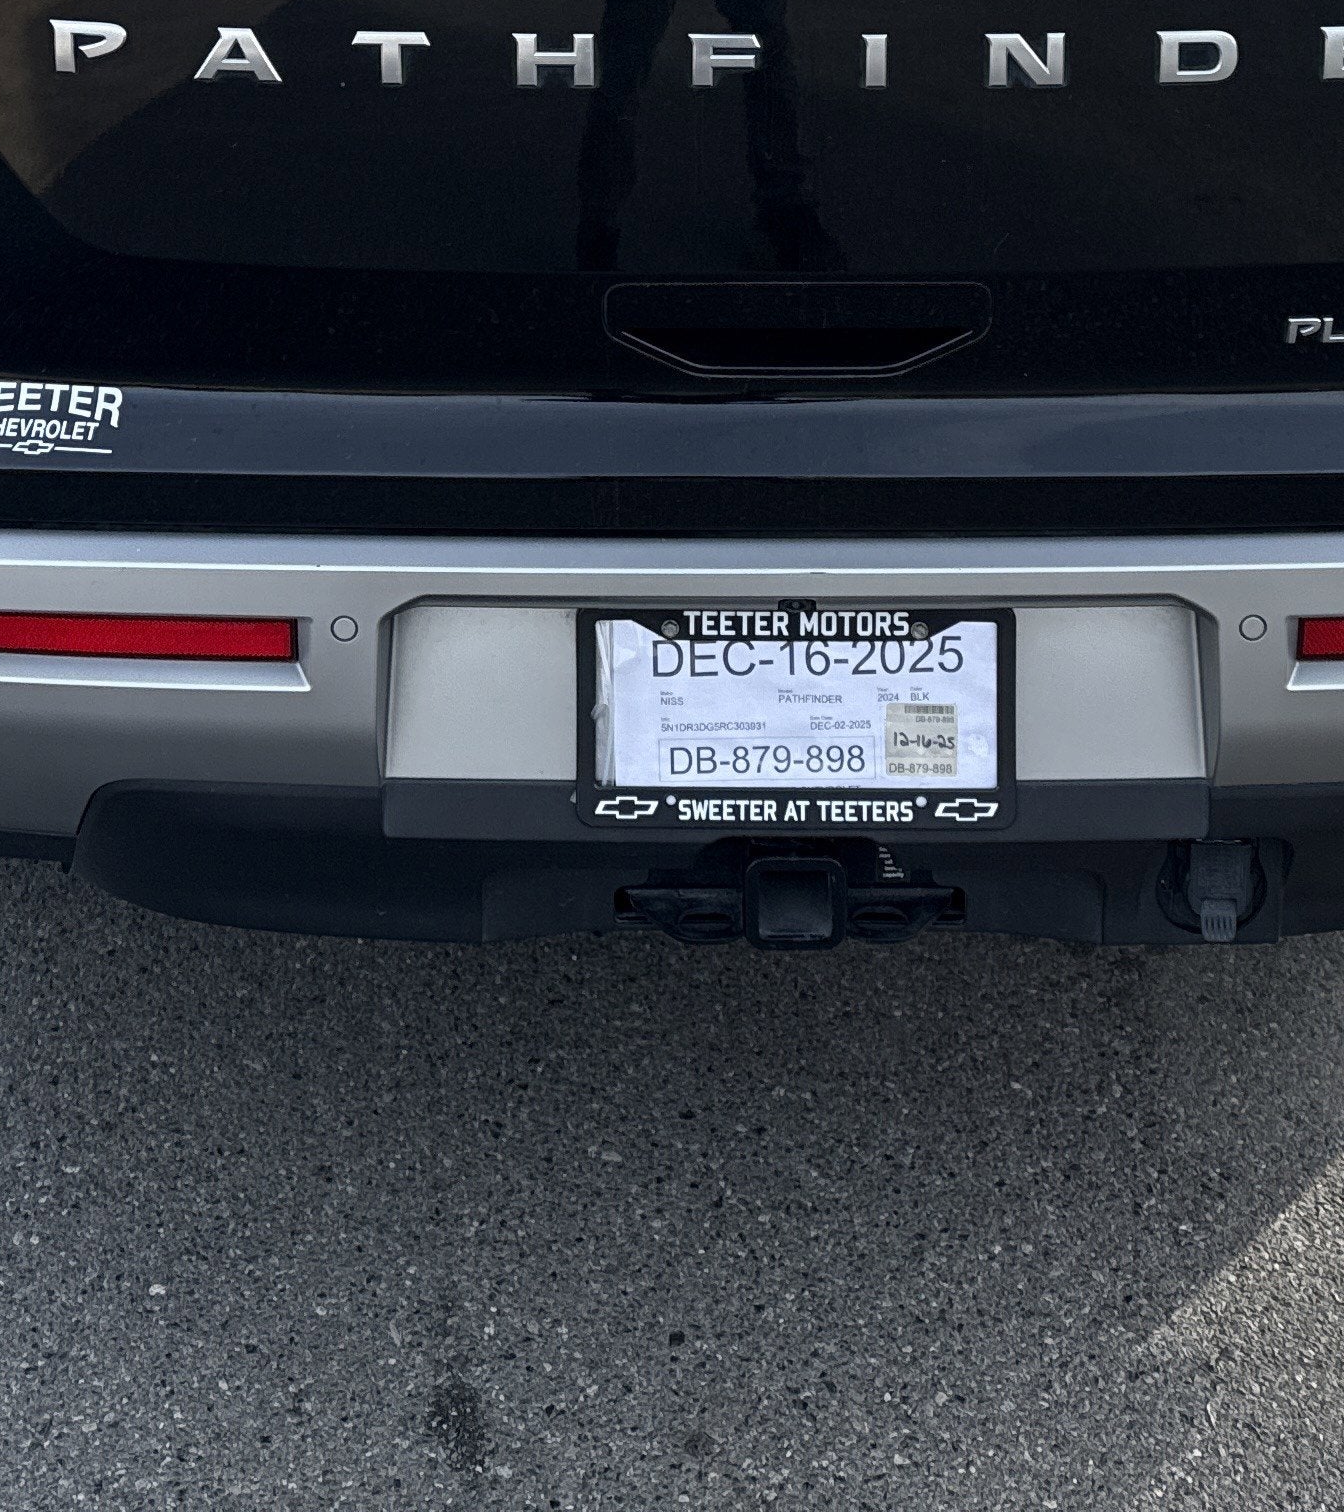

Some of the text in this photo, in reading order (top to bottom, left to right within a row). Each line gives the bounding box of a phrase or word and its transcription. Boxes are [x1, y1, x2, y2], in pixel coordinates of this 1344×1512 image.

[683, 611, 910, 637] TEETER MOTORS
[651, 635, 964, 678] DEC-16-2025
[660, 696, 684, 706] NISS
[778, 694, 843, 704] PATHFINDER
[877, 692, 900, 702] 2024
[910, 691, 930, 701] BLK
[810, 719, 872, 731] DEC-02-2025
[893, 731, 955, 750] 12-16-25
[669, 744, 866, 775] DB-879-898
[888, 763, 953, 774] DB-879-898
[678, 799, 914, 822] SWEETER AT TEETERS
